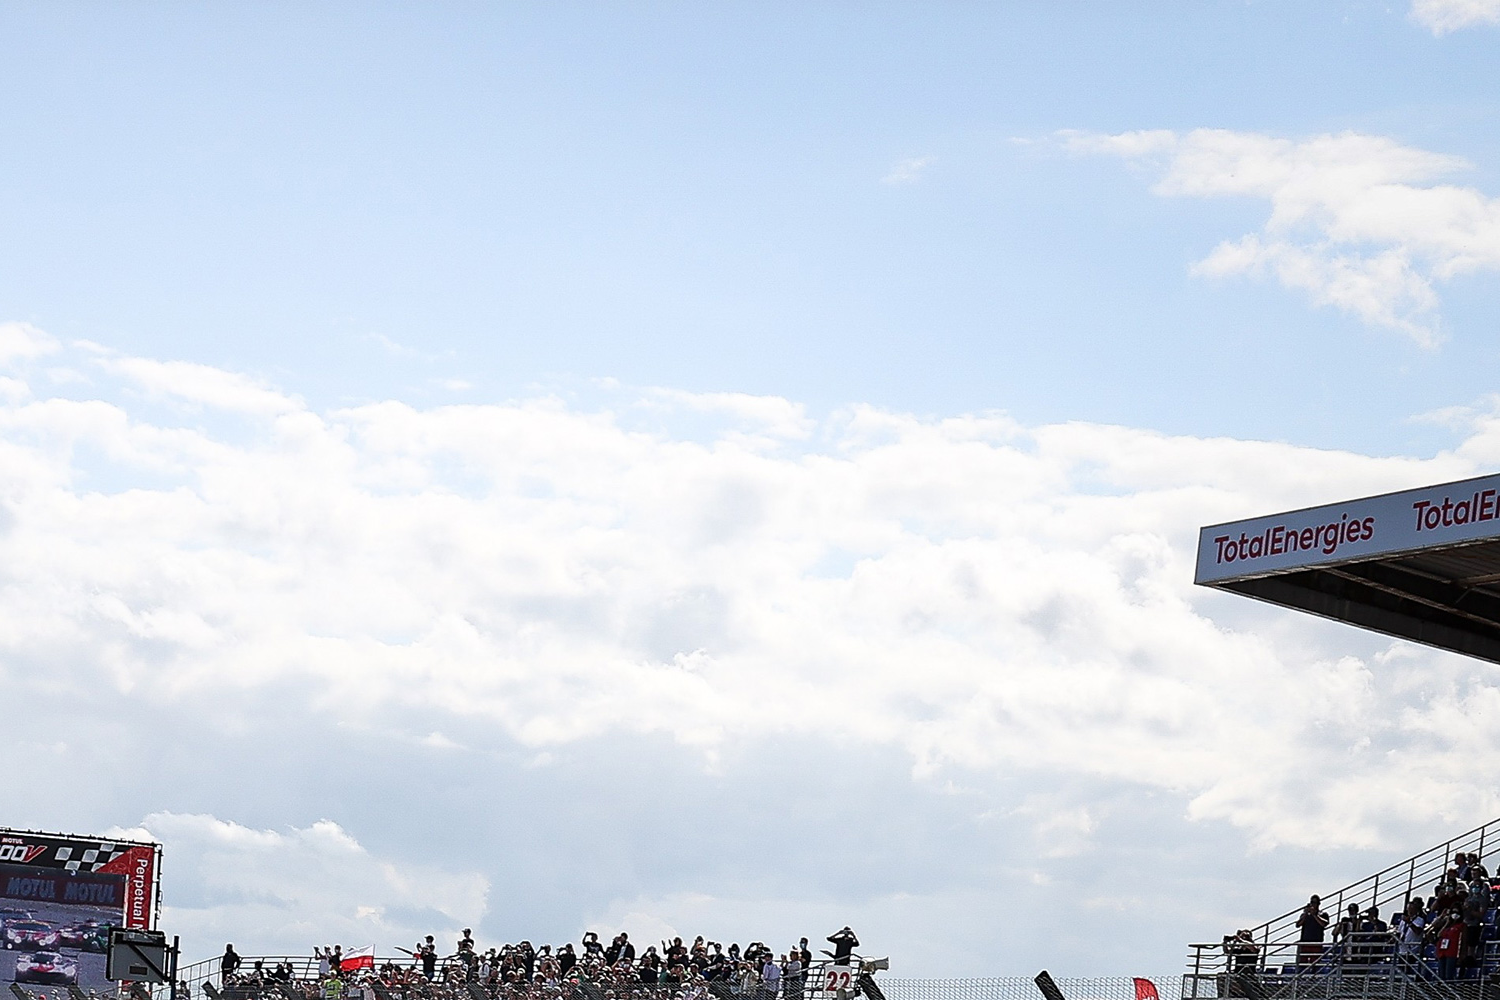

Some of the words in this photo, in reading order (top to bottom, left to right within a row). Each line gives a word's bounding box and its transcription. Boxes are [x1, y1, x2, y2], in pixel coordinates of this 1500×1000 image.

[1214, 512, 1375, 564] TotalEnergies
[7, 877, 55, 898] MOTUL
[64, 882, 115, 903] MOTUL
[132, 858, 148, 920] Perpetual
[825, 971, 850, 991] 22
